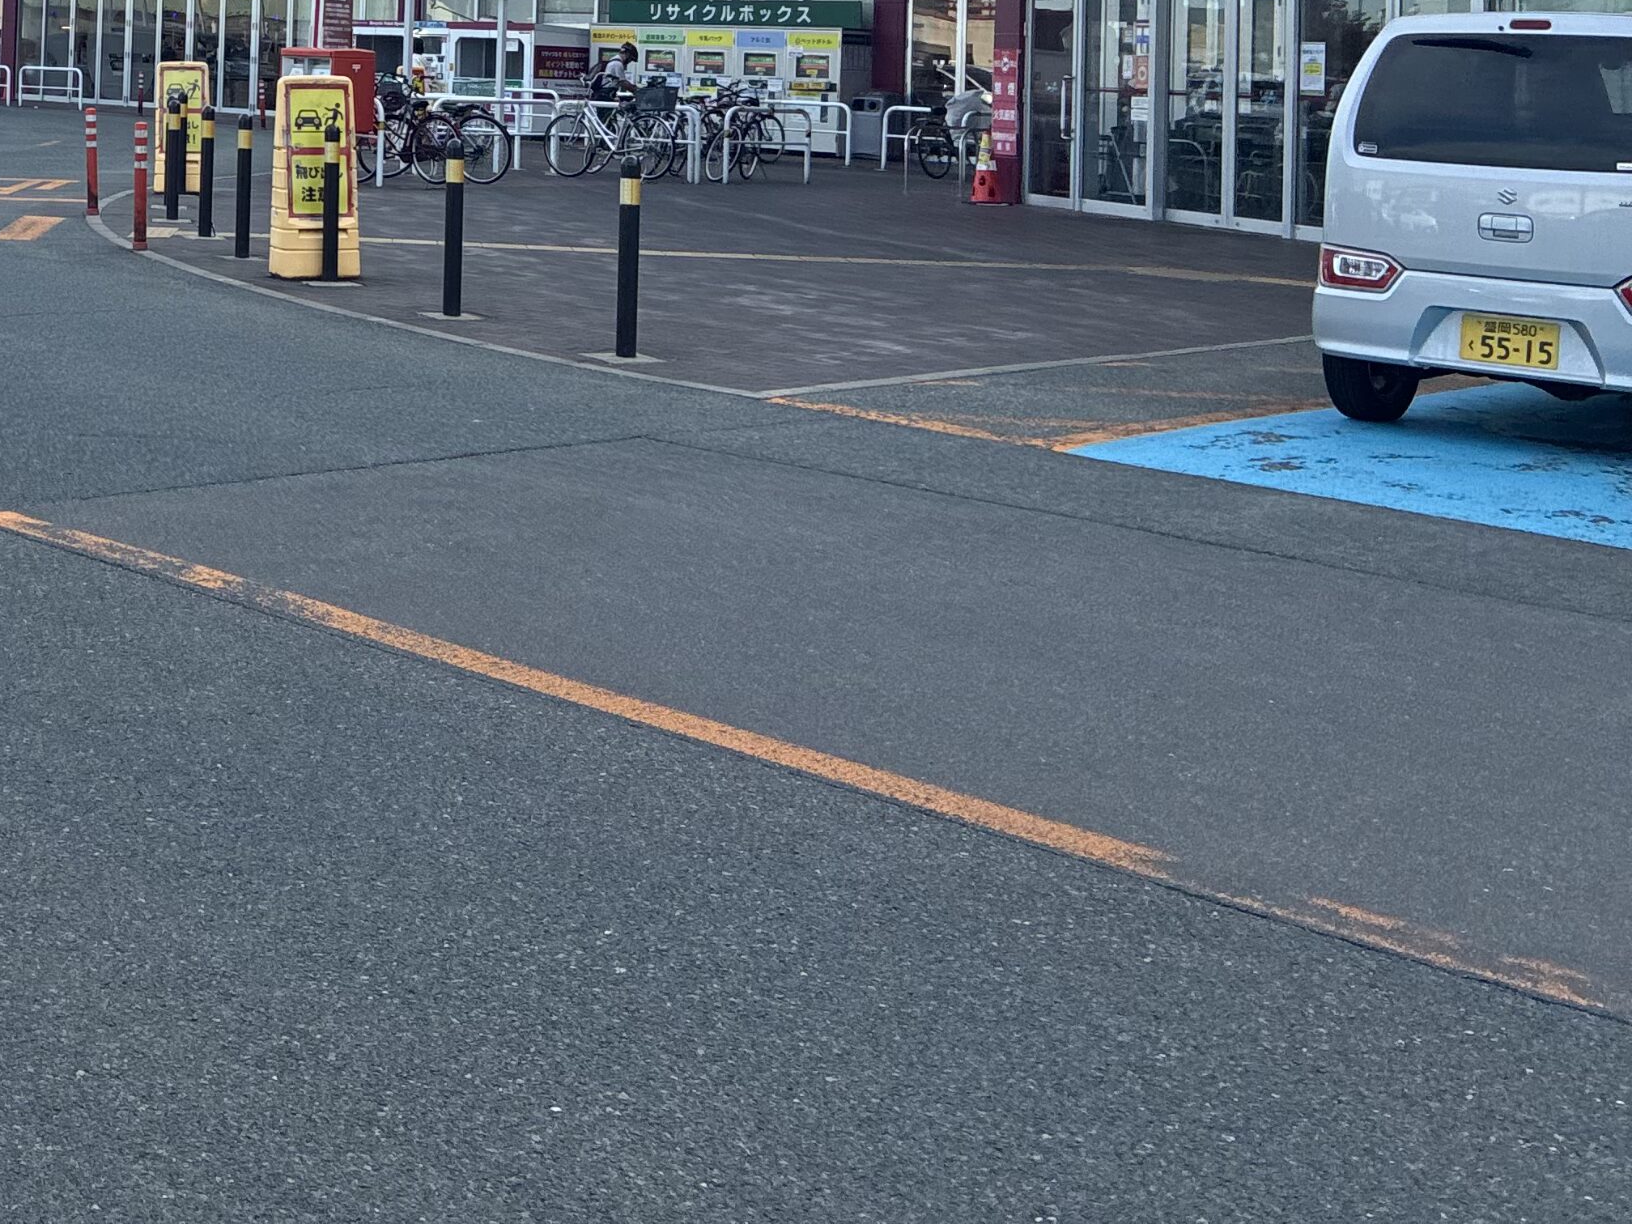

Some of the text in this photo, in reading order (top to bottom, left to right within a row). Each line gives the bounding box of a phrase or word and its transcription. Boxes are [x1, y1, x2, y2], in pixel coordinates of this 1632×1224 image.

[649, 3, 812, 24] リサイクルボックス
[1480, 335, 1553, 365] 55-15
